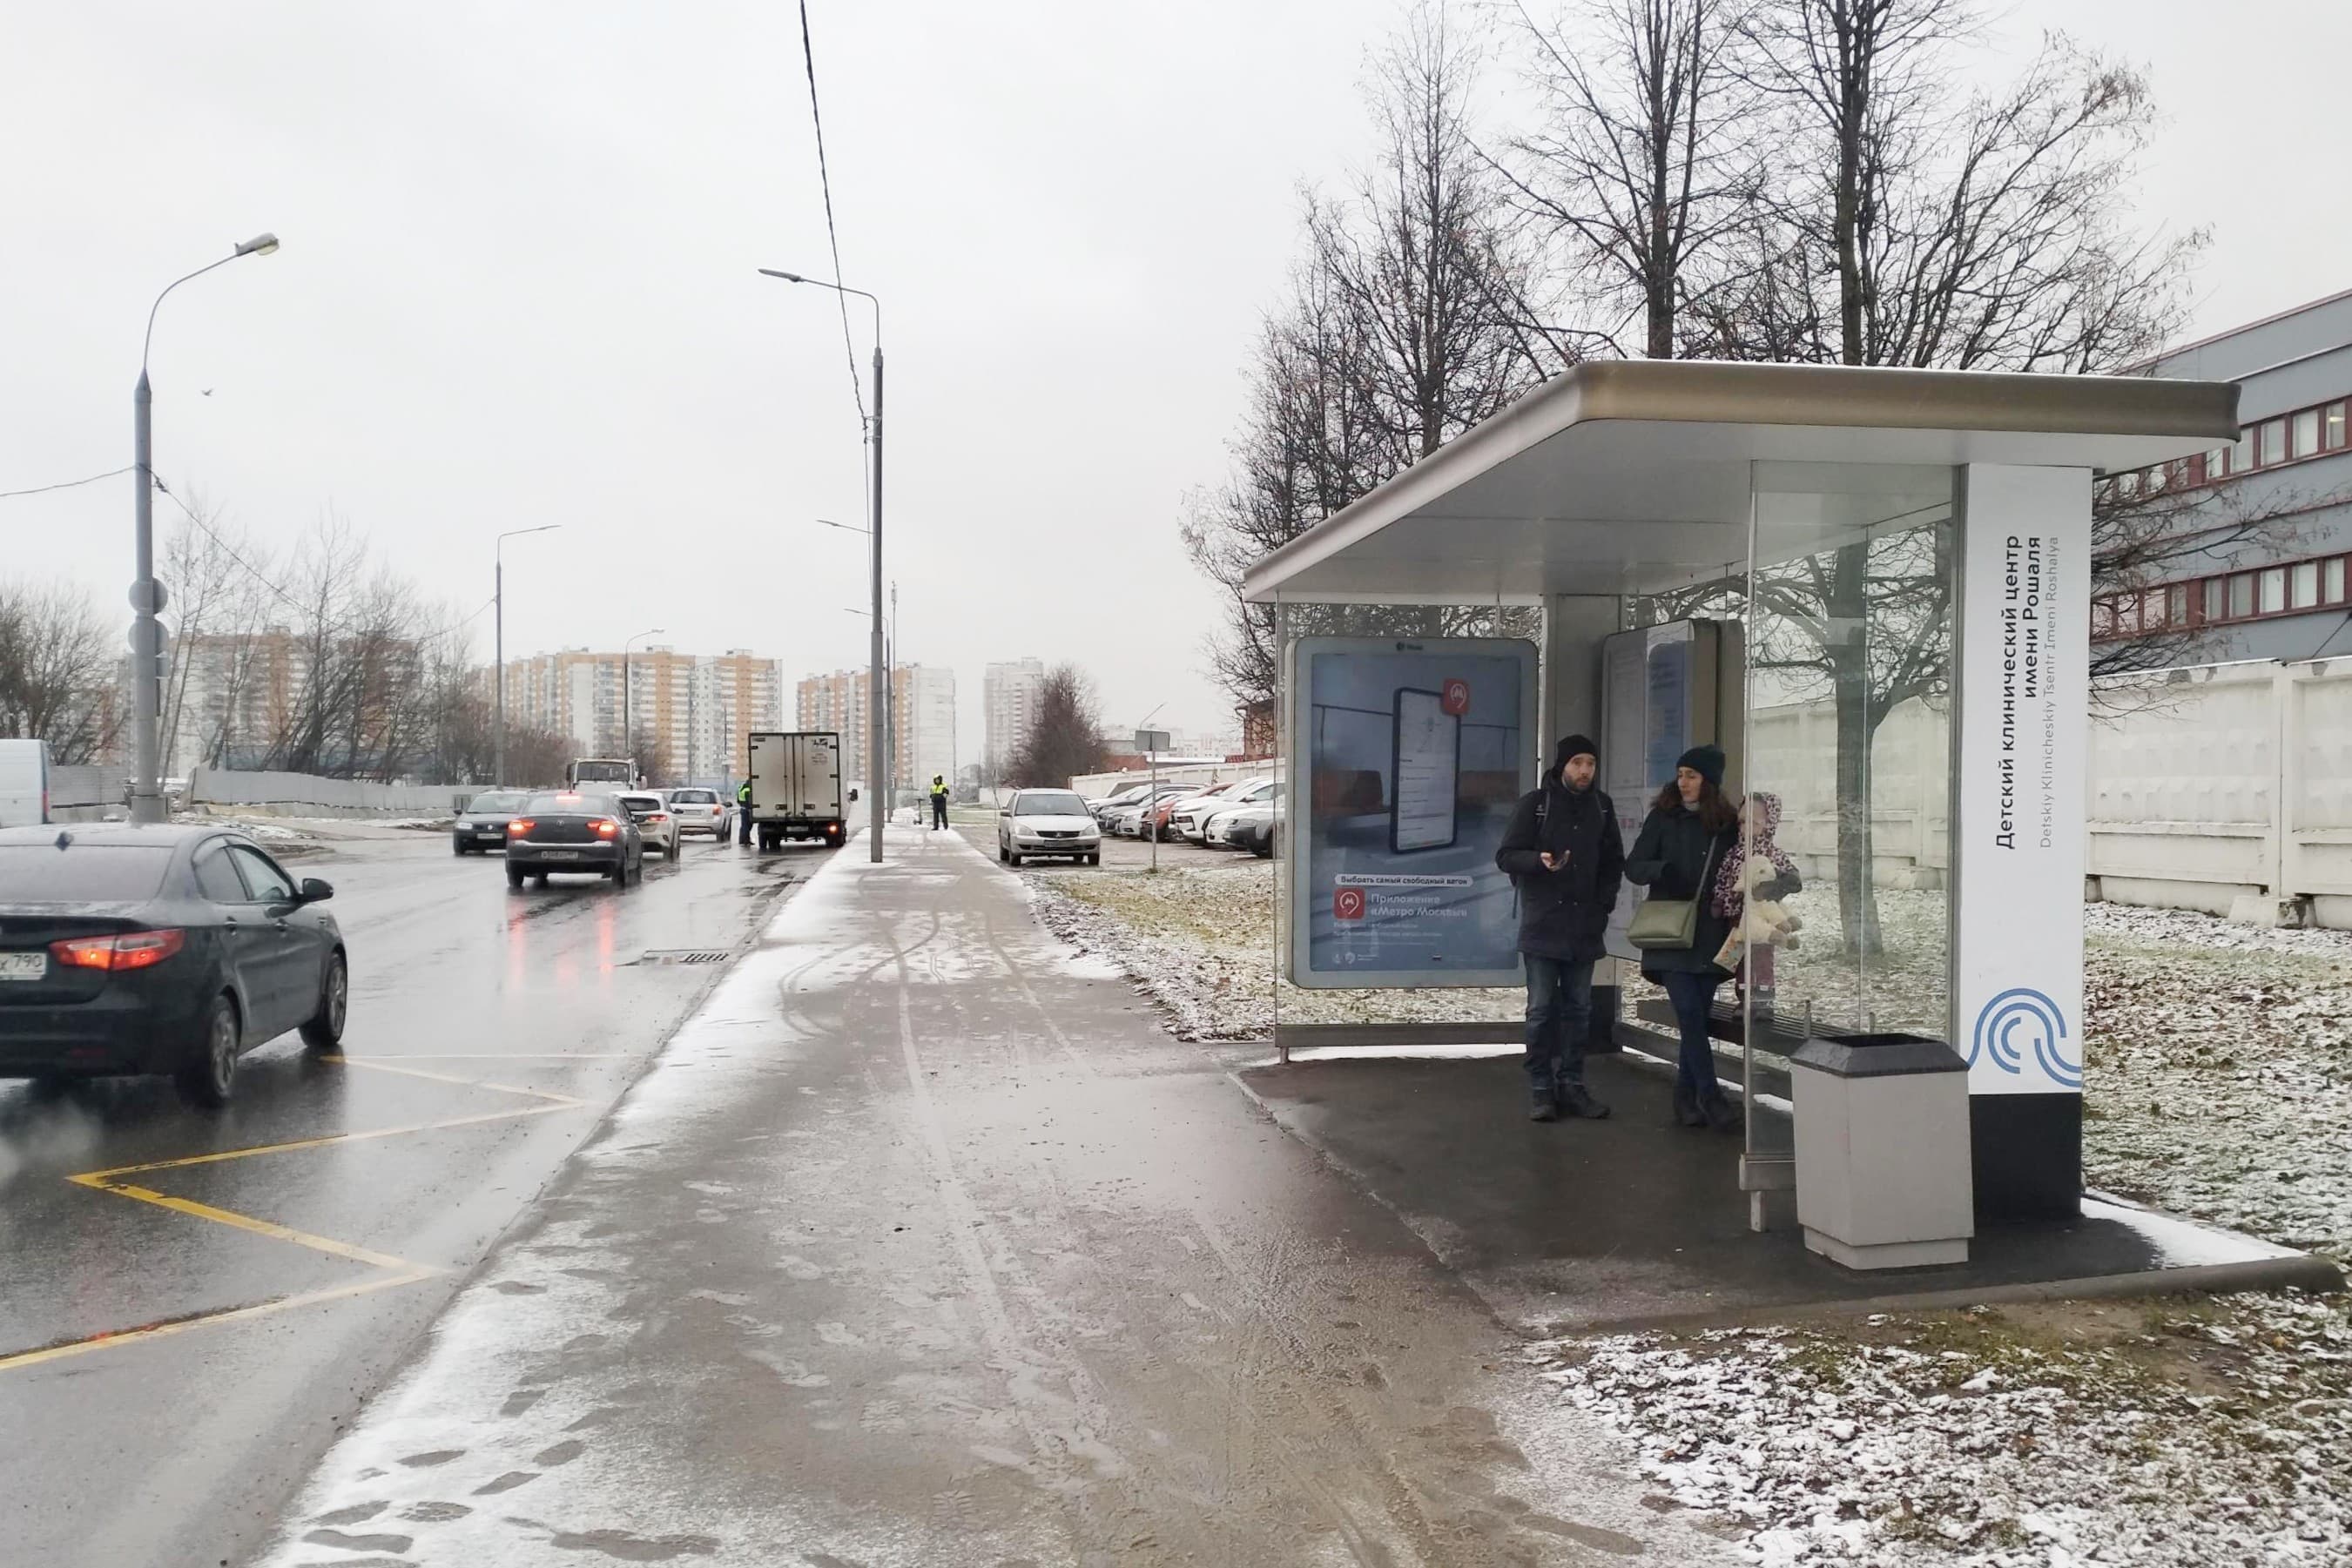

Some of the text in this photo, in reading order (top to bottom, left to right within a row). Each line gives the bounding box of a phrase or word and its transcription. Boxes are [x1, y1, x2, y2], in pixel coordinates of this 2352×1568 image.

[1996, 535, 2023, 850] Детский клинический центр
[2022, 536, 2040, 697] имени Рошаля
[2040, 536, 2060, 848] Detskiy Klinicheskiy Tsentr Imeni Roshalya
[1341, 876, 1375, 885] Выбрать
[1402, 876, 1445, 885] свободный
[1371, 893, 1440, 905] Приложение
